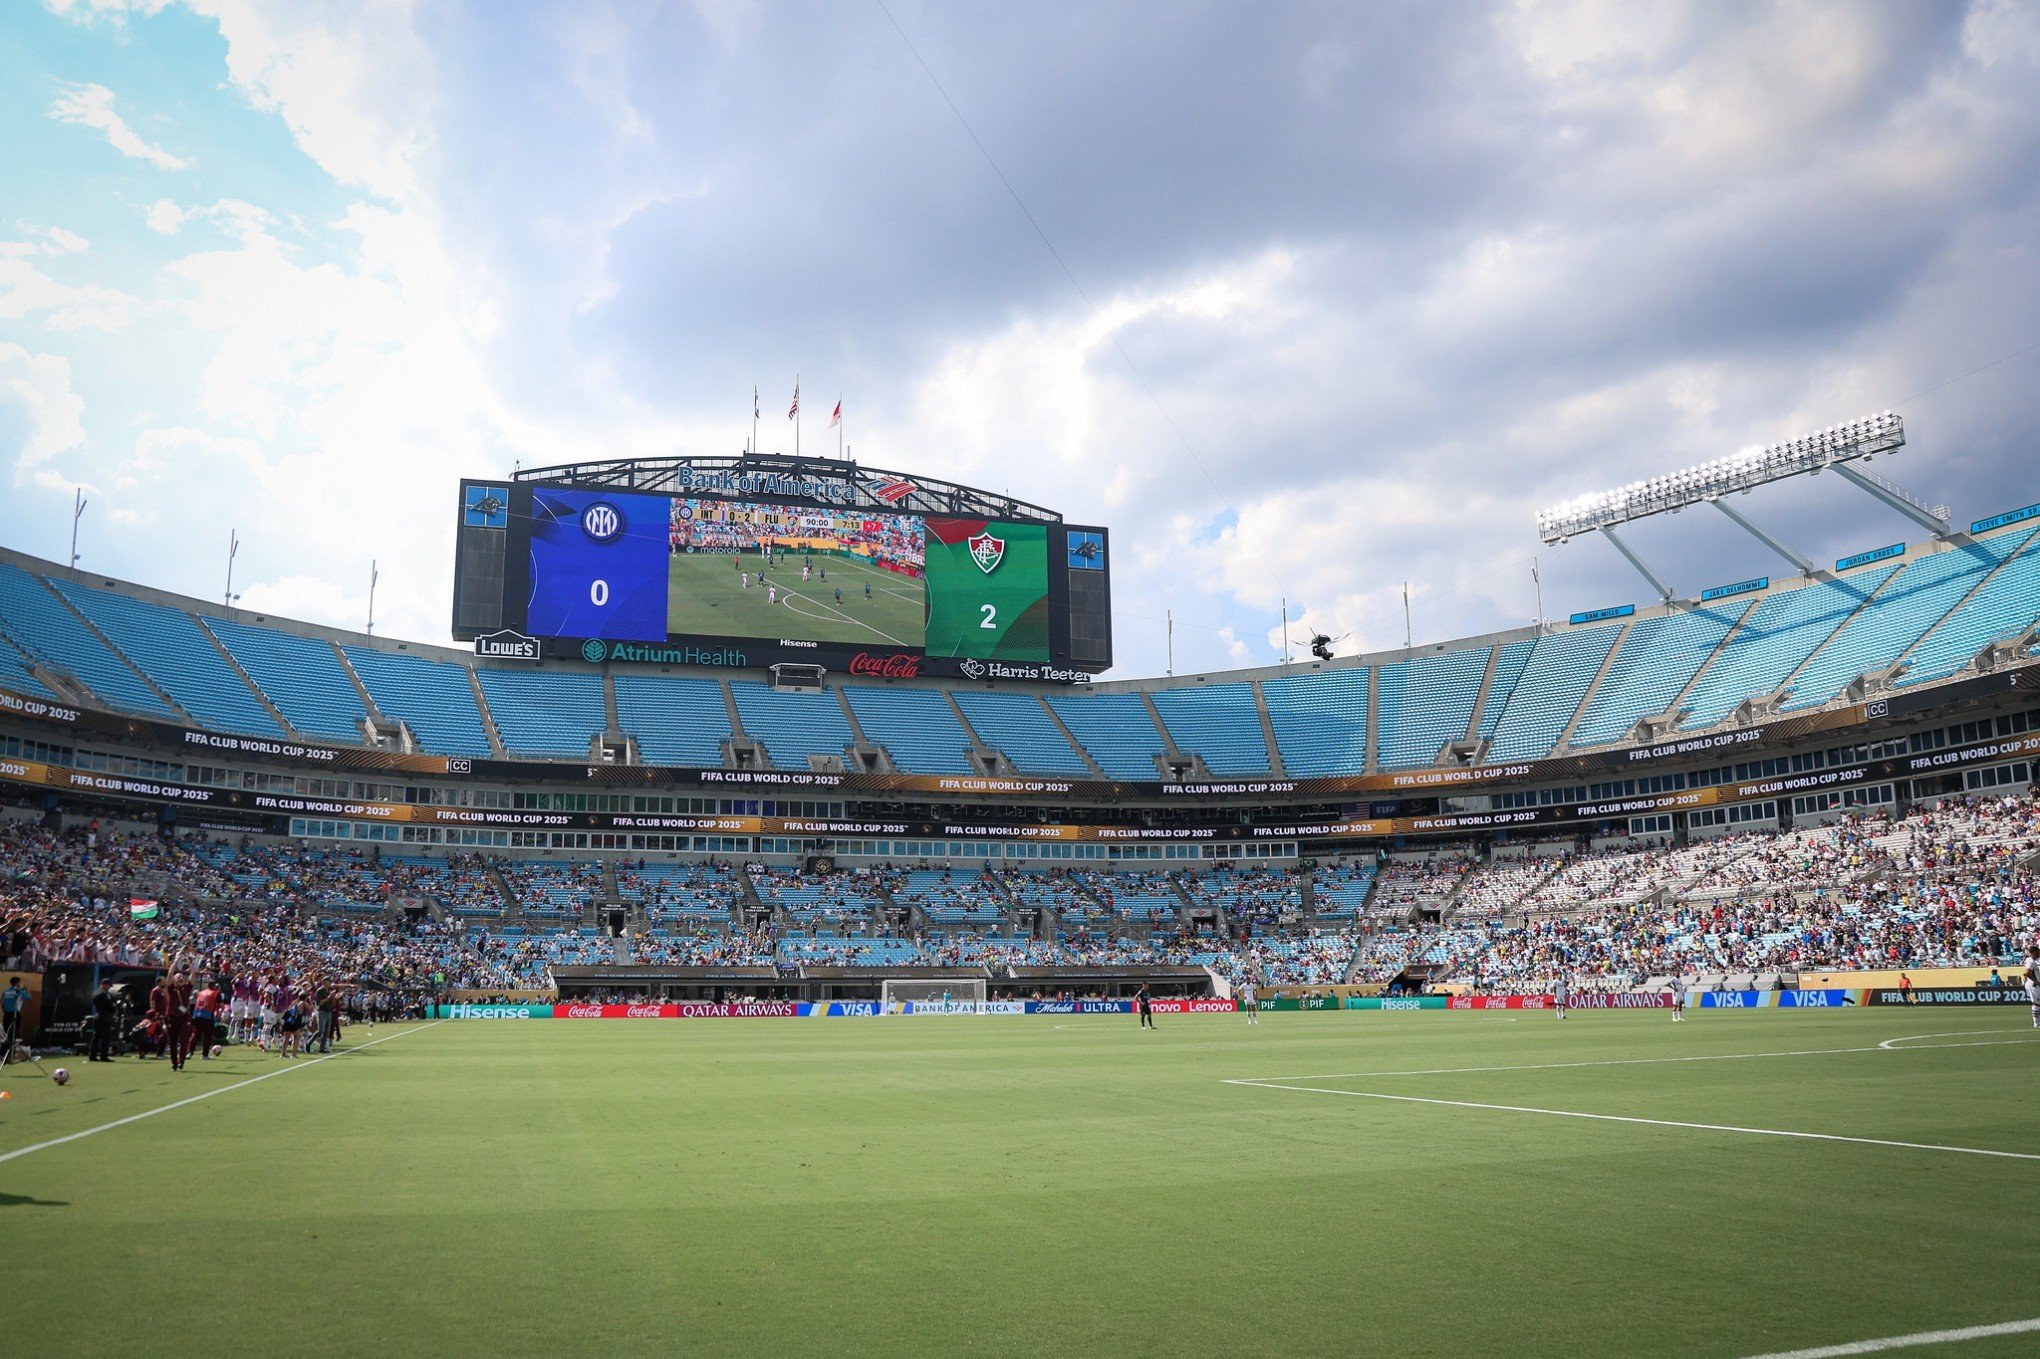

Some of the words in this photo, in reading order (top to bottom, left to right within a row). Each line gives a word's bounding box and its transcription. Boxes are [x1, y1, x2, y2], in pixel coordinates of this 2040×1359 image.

[677, 466, 735, 490] Bank
[738, 474, 762, 492] of
[763, 474, 856, 500] America
[700, 510, 714, 520] INT
[730, 512, 735, 520] 0
[745, 513, 750, 522] 2
[765, 514, 778, 524] FLU
[1978, 518, 1999, 530] STEVE
[2002, 512, 2025, 524] SMITH
[2027, 507, 2040, 517] SR.
[806, 518, 829, 527] 90:00
[842, 521, 860, 529] 7:13
[867, 522, 876, 530] +7
[700, 546, 741, 555] motorola
[1845, 554, 1870, 566] JORDAN
[1874, 548, 1895, 559] GROSS
[590, 579, 609, 606] 0
[1708, 588, 1724, 598] JAKE
[1726, 580, 1761, 595] DELHOMME
[979, 604, 997, 629] 2
[1584, 612, 1599, 620] SAM
[1602, 608, 1619, 618] MILLS
[481, 639, 534, 656] LOWE'S
[780, 639, 818, 648] Hisense
[611, 643, 682, 664] Atrium
[684, 646, 747, 667] Health
[849, 652, 922, 679] Coca-Cola
[988, 664, 1038, 680] Harris
[1041, 665, 1091, 682] Teeter
[24, 701, 47, 715] CUP
[1870, 704, 1886, 715] CC
[185, 732, 208, 745] FIFA
[209, 736, 238, 749] CLUB
[240, 740, 281, 754] WORLD
[282, 745, 305, 757] CUP
[1629, 749, 1651, 761] FIFA
[1652, 745, 1676, 757] CLUB
[1677, 738, 1713, 753] WORLD
[1713, 734, 1734, 746] CUP
[1910, 757, 1932, 770] FIFA
[1932, 752, 1959, 765] CLUB
[1959, 745, 1998, 761] WORLD
[1999, 741, 2022, 754] CUP
[452, 760, 468, 770] CC
[701, 772, 724, 781] FIFA
[725, 772, 752, 782] CLUB
[753, 773, 791, 784] WORLD
[792, 774, 813, 784] CUP
[1394, 776, 1416, 785] FIFA
[1417, 773, 1442, 784] CLUB
[1443, 770, 1482, 781] WORLD
[1482, 768, 1503, 778] CUP
[70, 774, 94, 787] FIFA
[95, 777, 122, 790] CLUB
[123, 781, 161, 795] WORLD
[161, 786, 182, 797] CUP
[939, 779, 961, 789] FIFA
[961, 780, 987, 790] CLUB
[988, 781, 1024, 791] WORLD
[1024, 782, 1044, 791] CUP
[1163, 785, 1184, 794] FIFA
[1184, 785, 1210, 794] CLUB
[1210, 784, 1247, 793] WORLD
[1247, 783, 1268, 793] CUP
[1738, 785, 1759, 796] FIFA
[1759, 781, 1784, 793] CLUB
[1784, 776, 1818, 790] WORLD
[1819, 773, 1838, 784] CUP
[256, 797, 277, 807] FIFA
[278, 799, 304, 810] CLUB
[305, 801, 343, 813] WORLD
[344, 804, 365, 814] CUP
[1577, 806, 1598, 816] FIFA
[1598, 803, 1621, 813] CLUB
[1621, 799, 1656, 811] WORLD
[1656, 797, 1675, 807] CUP
[436, 810, 458, 820] FIFA
[459, 811, 485, 821] CLUB
[486, 813, 522, 823] WORLD
[522, 814, 543, 823] CUP
[613, 817, 635, 826] FIFA
[635, 818, 660, 827] CLUB
[661, 818, 696, 828] WORLD
[697, 819, 717, 828] CUP
[1413, 820, 1433, 829] FIFA
[1433, 818, 1458, 828] CLUB
[1458, 816, 1492, 826] WORLD
[1493, 814, 1512, 823] CUP
[783, 822, 804, 831] FIFA
[804, 822, 828, 831] CLUB
[829, 823, 862, 832] WORLD
[863, 824, 882, 832] CUP
[945, 826, 964, 834] FIFA
[964, 826, 987, 835] CLUB
[988, 826, 1020, 835] WORLD
[1021, 827, 1039, 836] CUP
[1253, 827, 1273, 836] FIFA
[1273, 827, 1296, 835] CLUB
[1297, 825, 1330, 835] WORLD
[1330, 824, 1349, 833] CUP
[1098, 829, 1117, 838] FIFA
[1117, 829, 1140, 838] CLUB
[1140, 829, 1172, 837] WORLD
[1173, 829, 1191, 837] CUP
[1569, 994, 1606, 1009] QATAR
[1612, 994, 1664, 1008] AIRWAYS
[1711, 992, 1744, 1007] VISA
[1791, 991, 1828, 1006] VISA
[1882, 992, 1904, 1002] FIFA
[1934, 992, 1975, 1002] WORLD
[1978, 991, 2000, 1002] CUP
[841, 1004, 873, 1016] VISA
[1036, 1002, 1074, 1012] Michelob
[1084, 1003, 1120, 1012] ULTRA
[1189, 1000, 1233, 1012] Lenovo
[1261, 1001, 1276, 1010] PIF
[1310, 1000, 1324, 1008] PIF
[1382, 998, 1420, 1010] Hisense
[450, 1005, 530, 1019] Hisense
[568, 1006, 603, 1018] Coca-Cola
[627, 1006, 662, 1018] Coca-Cola
[683, 1006, 728, 1018] QATAR
[735, 1004, 792, 1016] AIRWAYS
